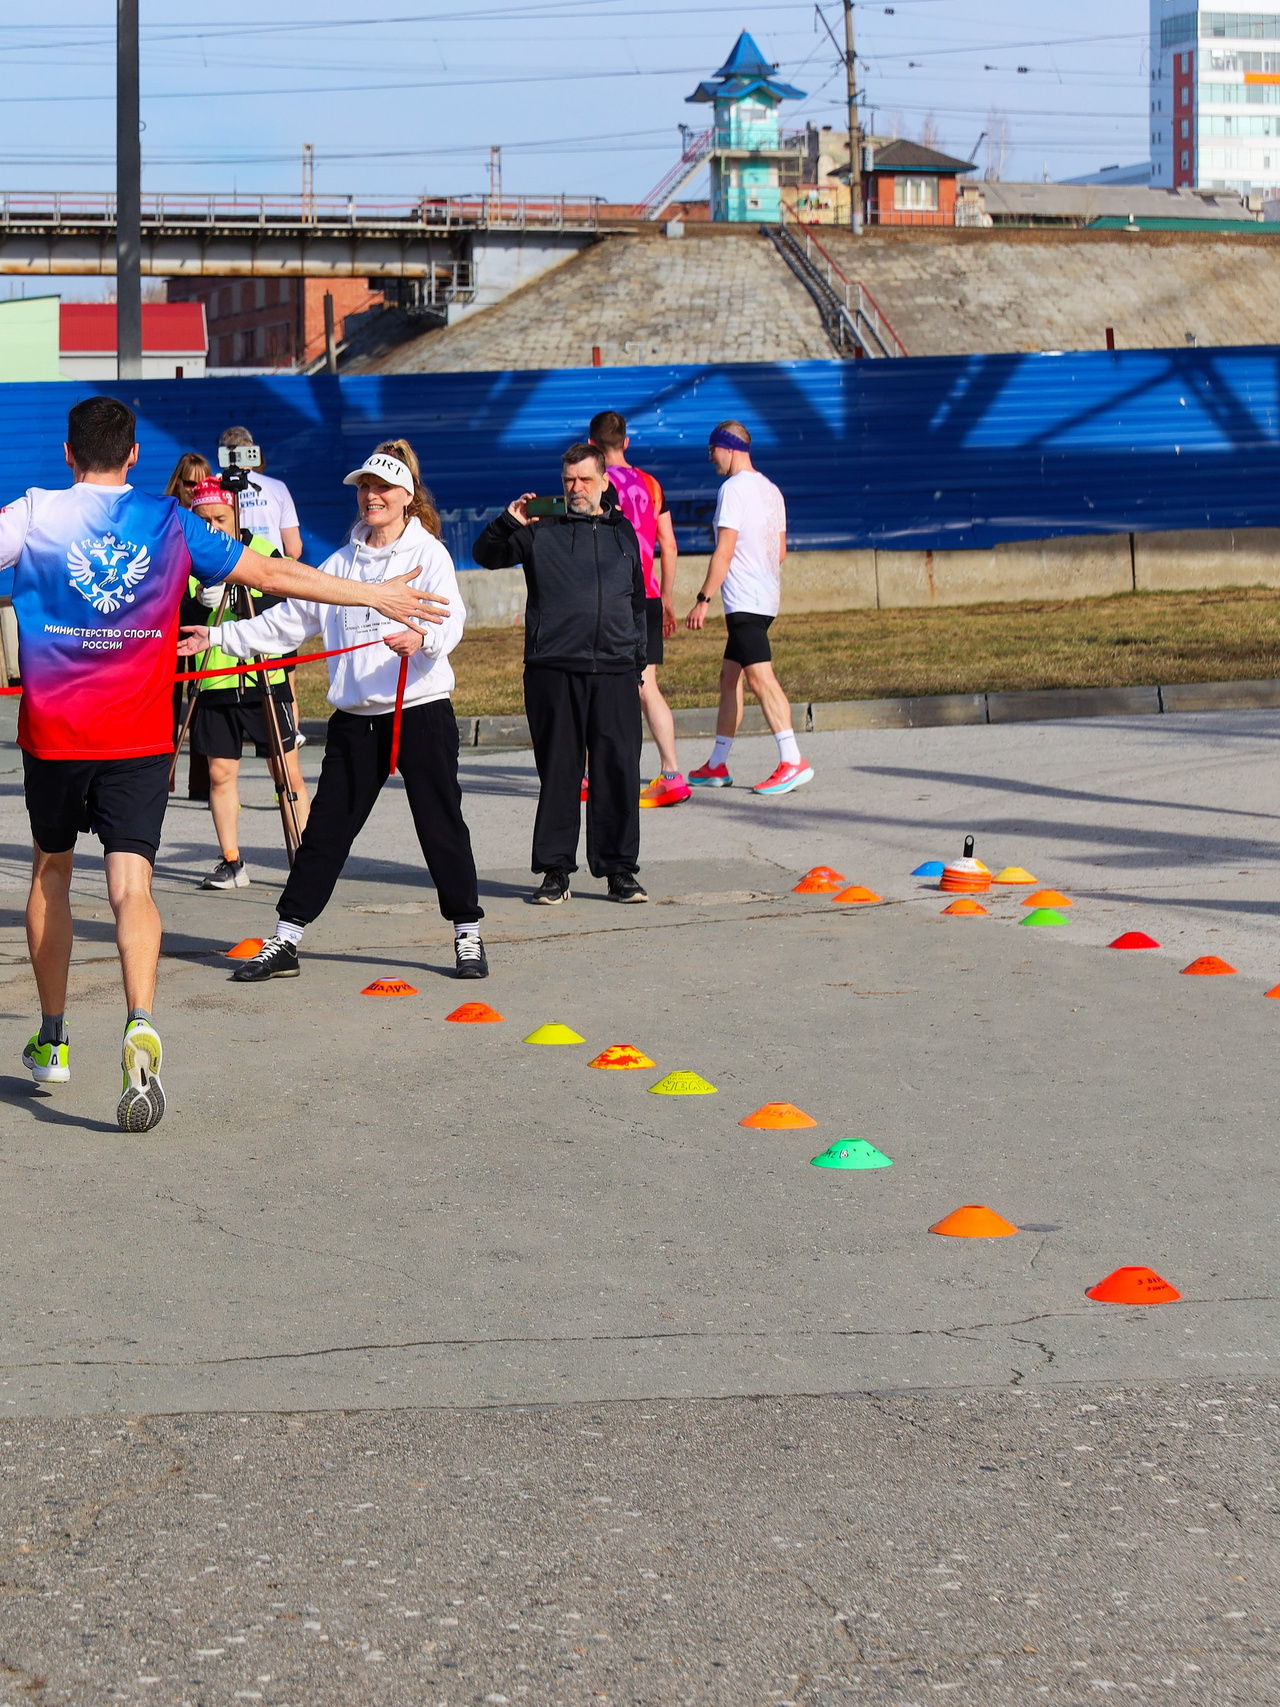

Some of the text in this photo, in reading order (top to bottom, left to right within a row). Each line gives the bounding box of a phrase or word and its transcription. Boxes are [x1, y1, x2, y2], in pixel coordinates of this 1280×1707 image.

[44, 624, 163, 639] МИНИСТЕРСТВО СПОРТА
[82, 640, 123, 650] РОССИИ
